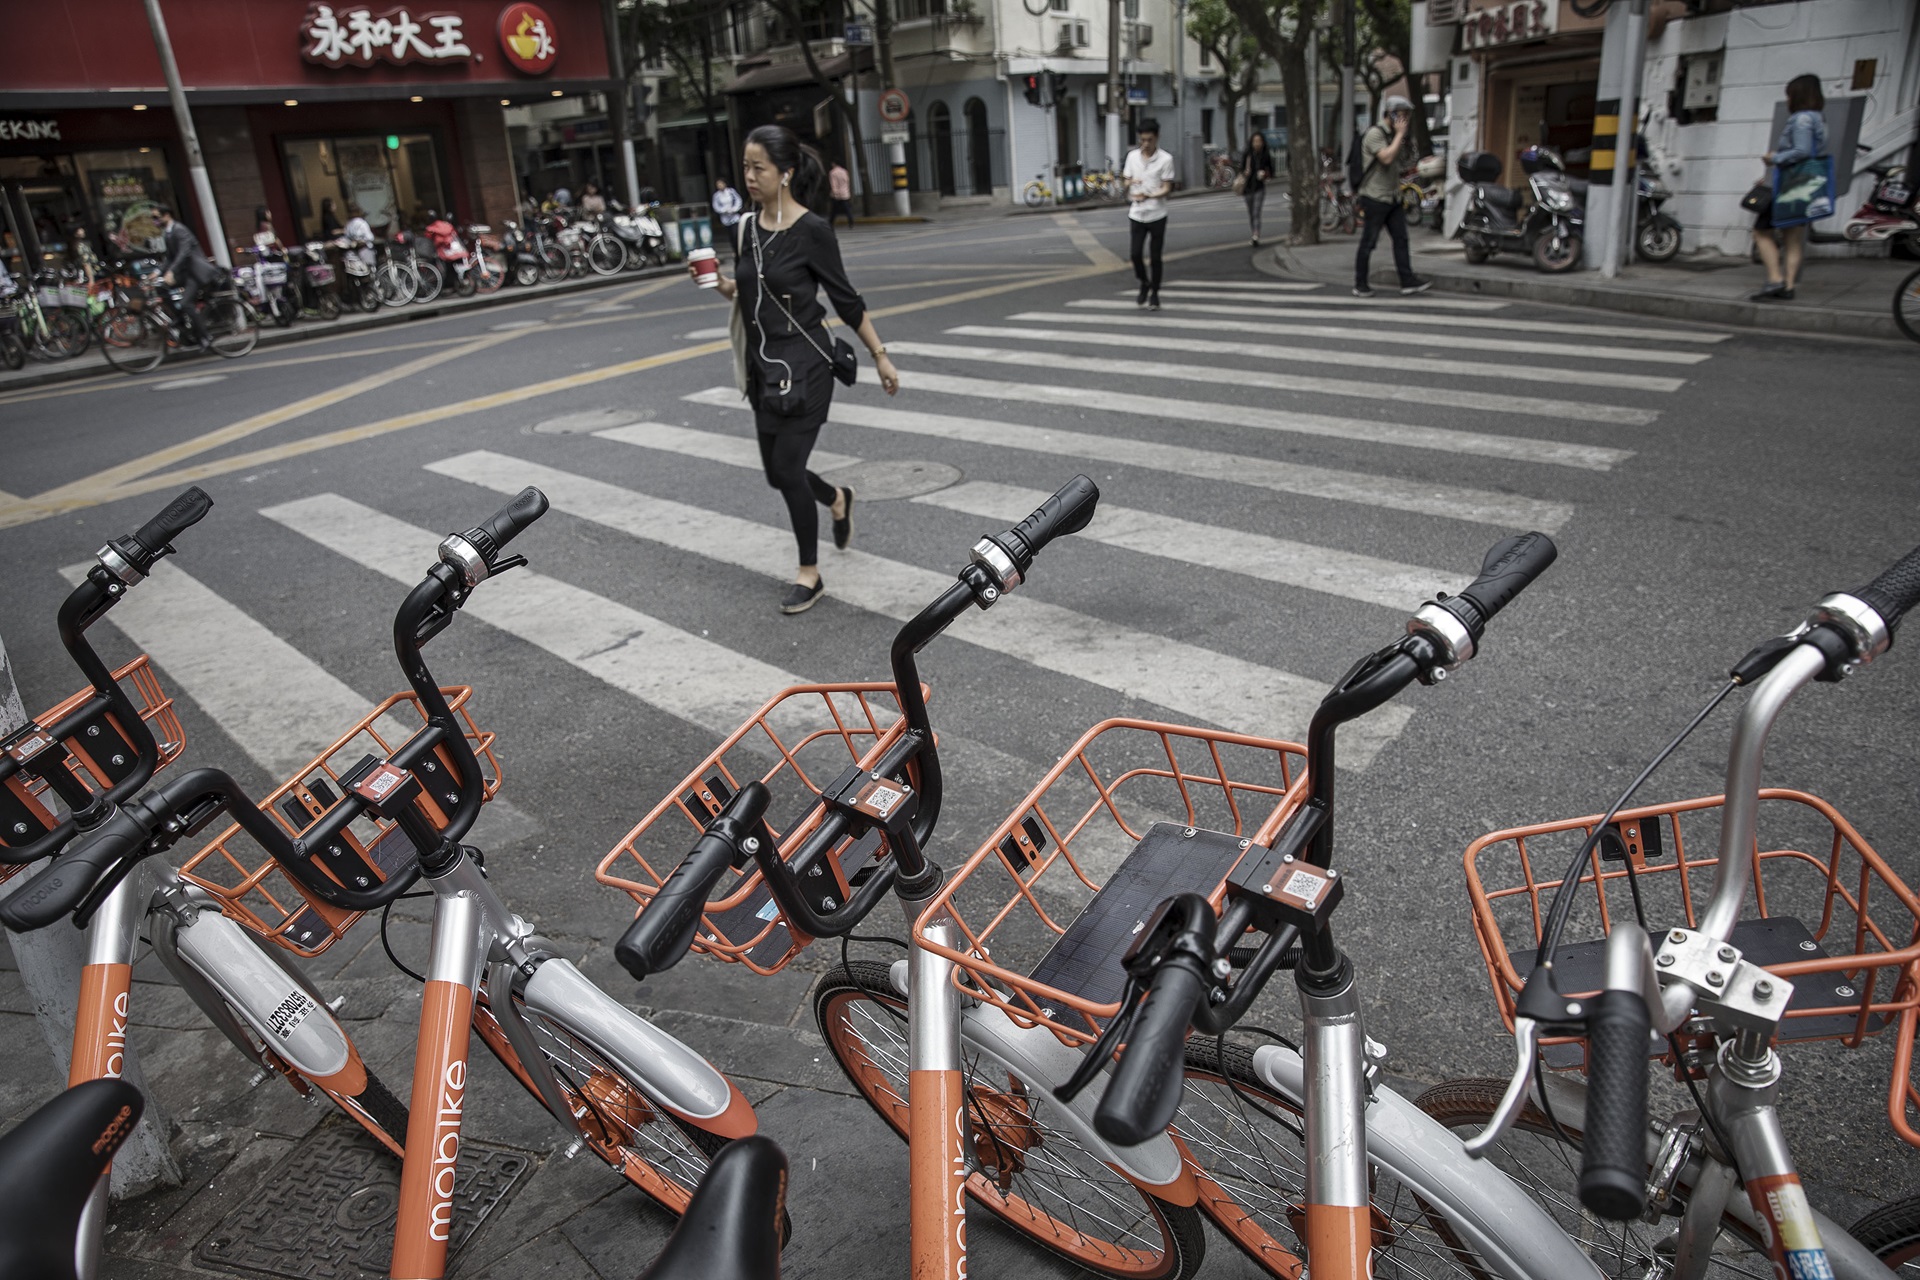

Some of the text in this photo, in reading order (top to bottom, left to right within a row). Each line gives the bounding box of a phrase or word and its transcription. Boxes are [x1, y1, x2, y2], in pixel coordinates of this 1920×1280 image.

[309, 6, 471, 61] 永和大王
[91, 1105, 132, 1155] mobike
[429, 1060, 467, 1241] mobike
